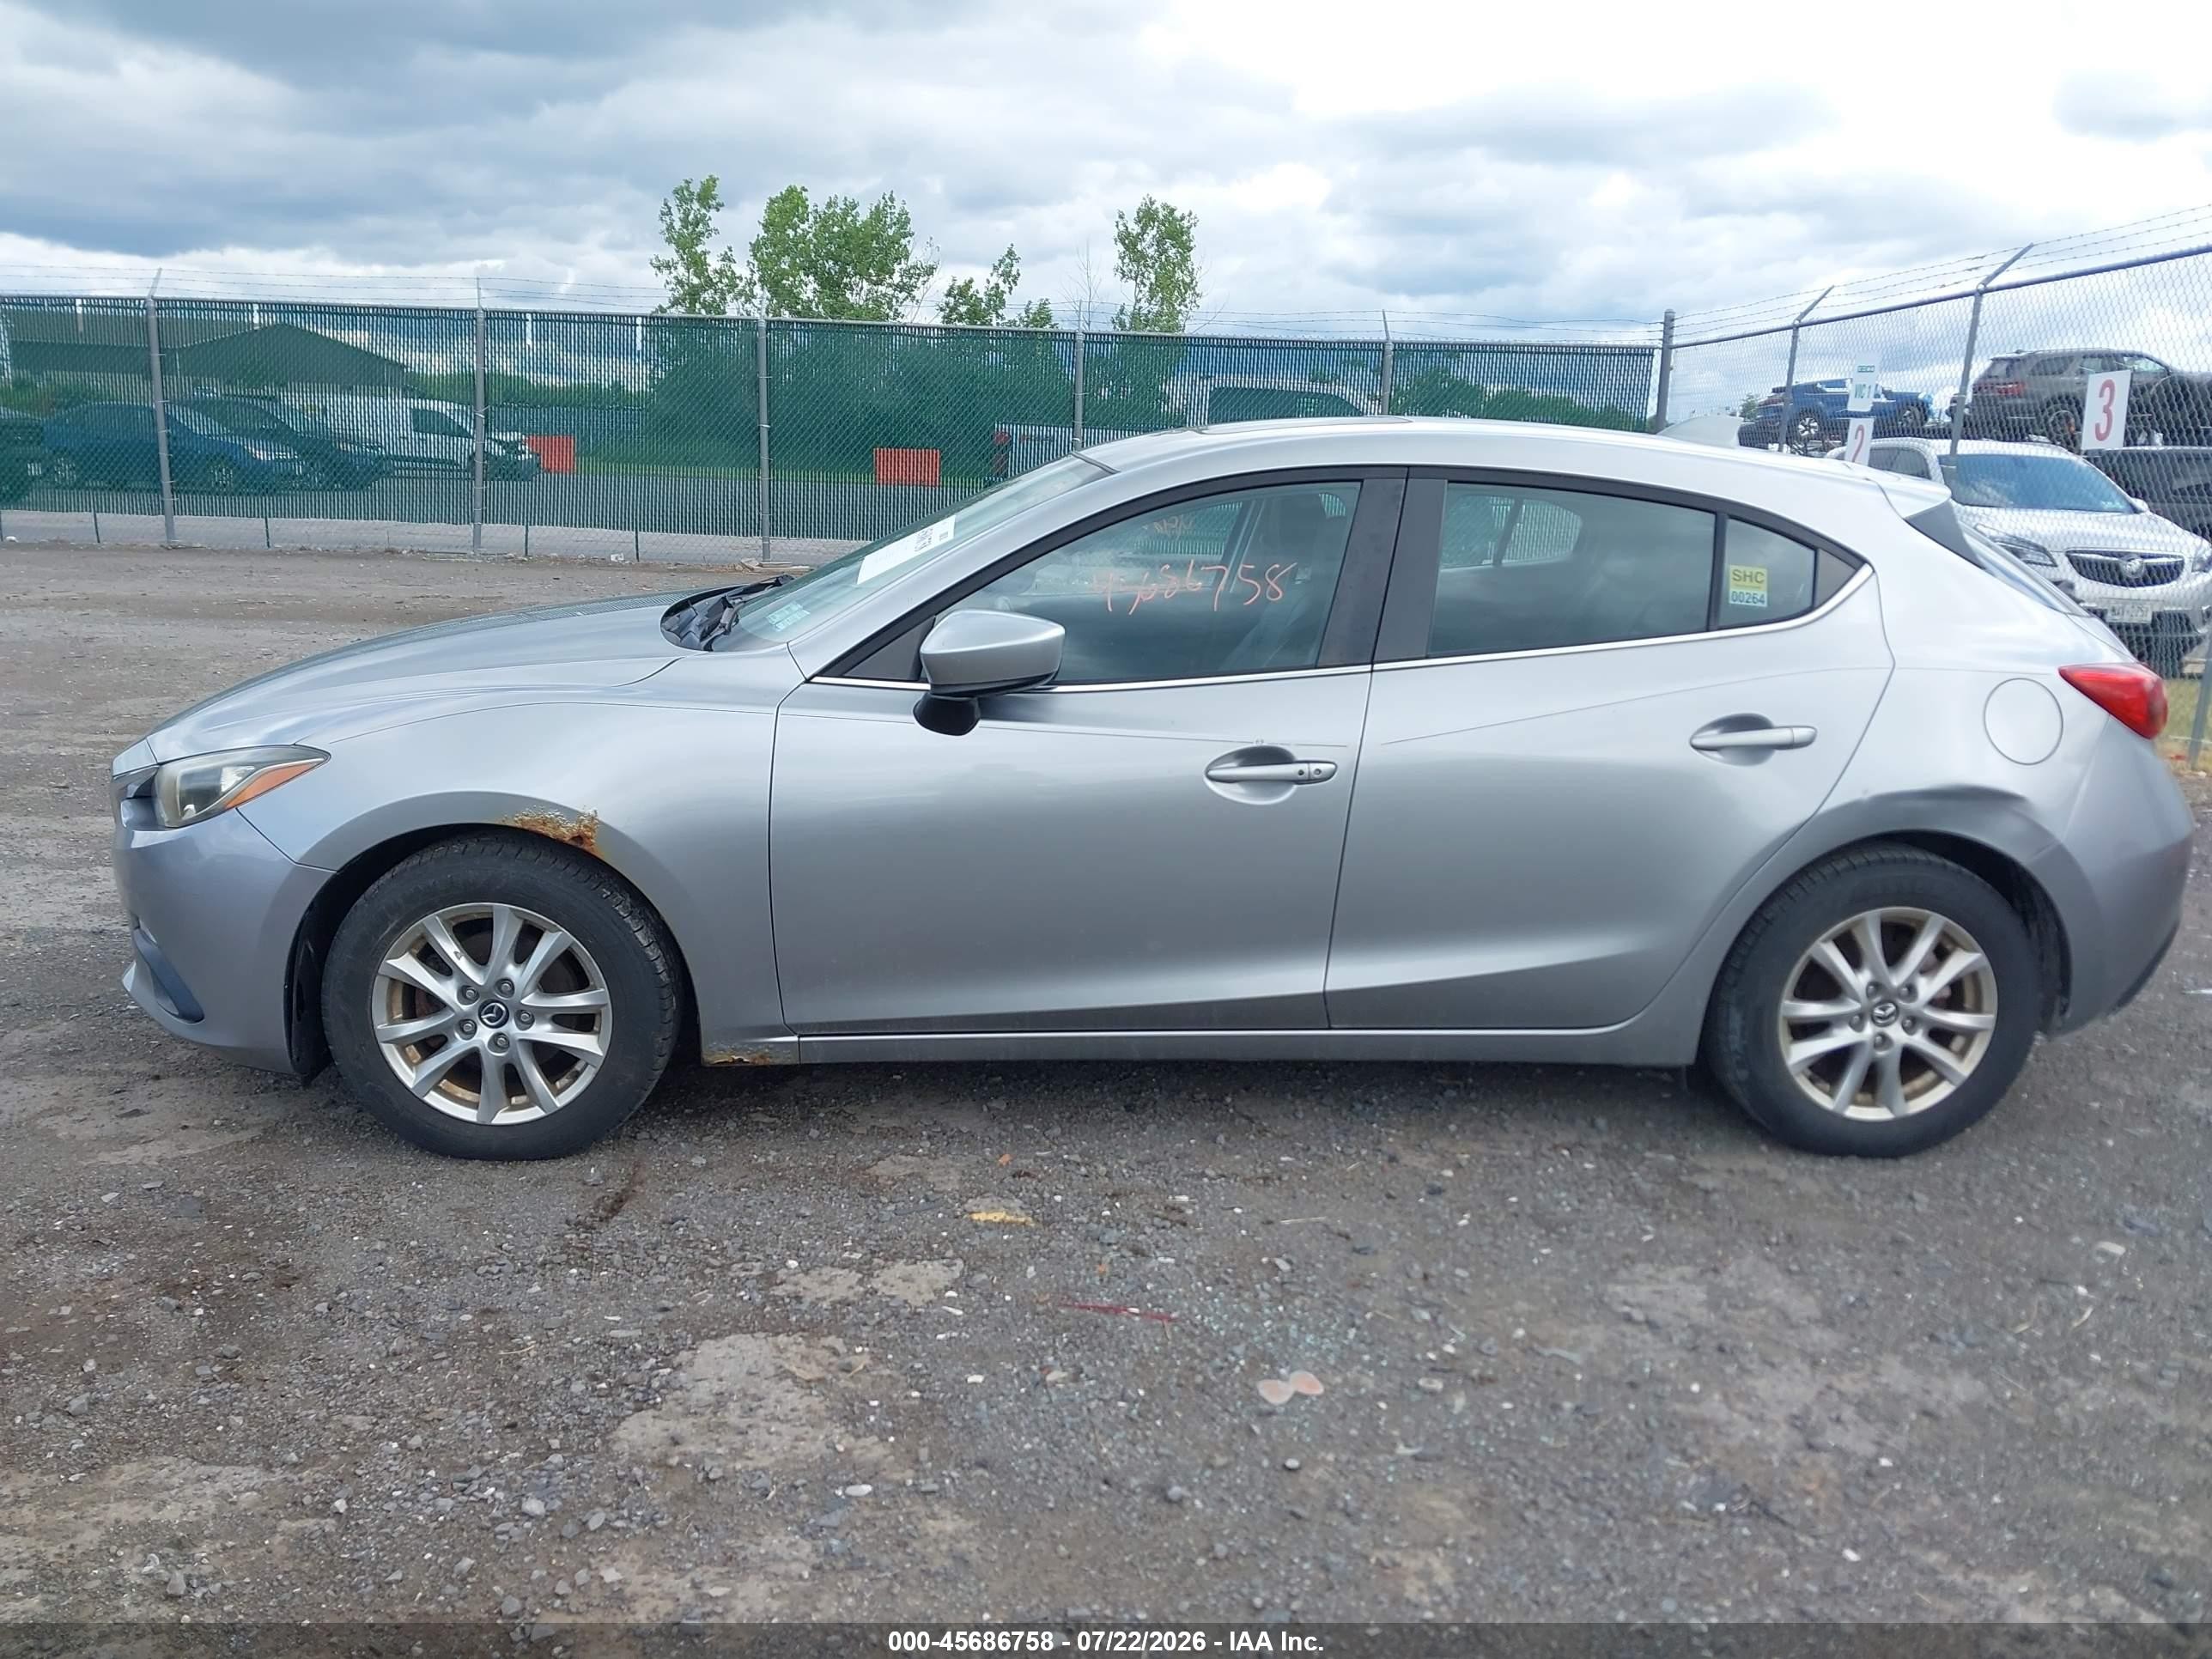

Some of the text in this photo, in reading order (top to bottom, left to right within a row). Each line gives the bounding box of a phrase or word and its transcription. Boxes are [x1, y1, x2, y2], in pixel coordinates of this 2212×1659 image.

[2094, 379, 2116, 441] 3
[1851, 424, 1865, 463] 2
[1732, 568, 1765, 584] SHC
[1731, 591, 1765, 605] 00264
